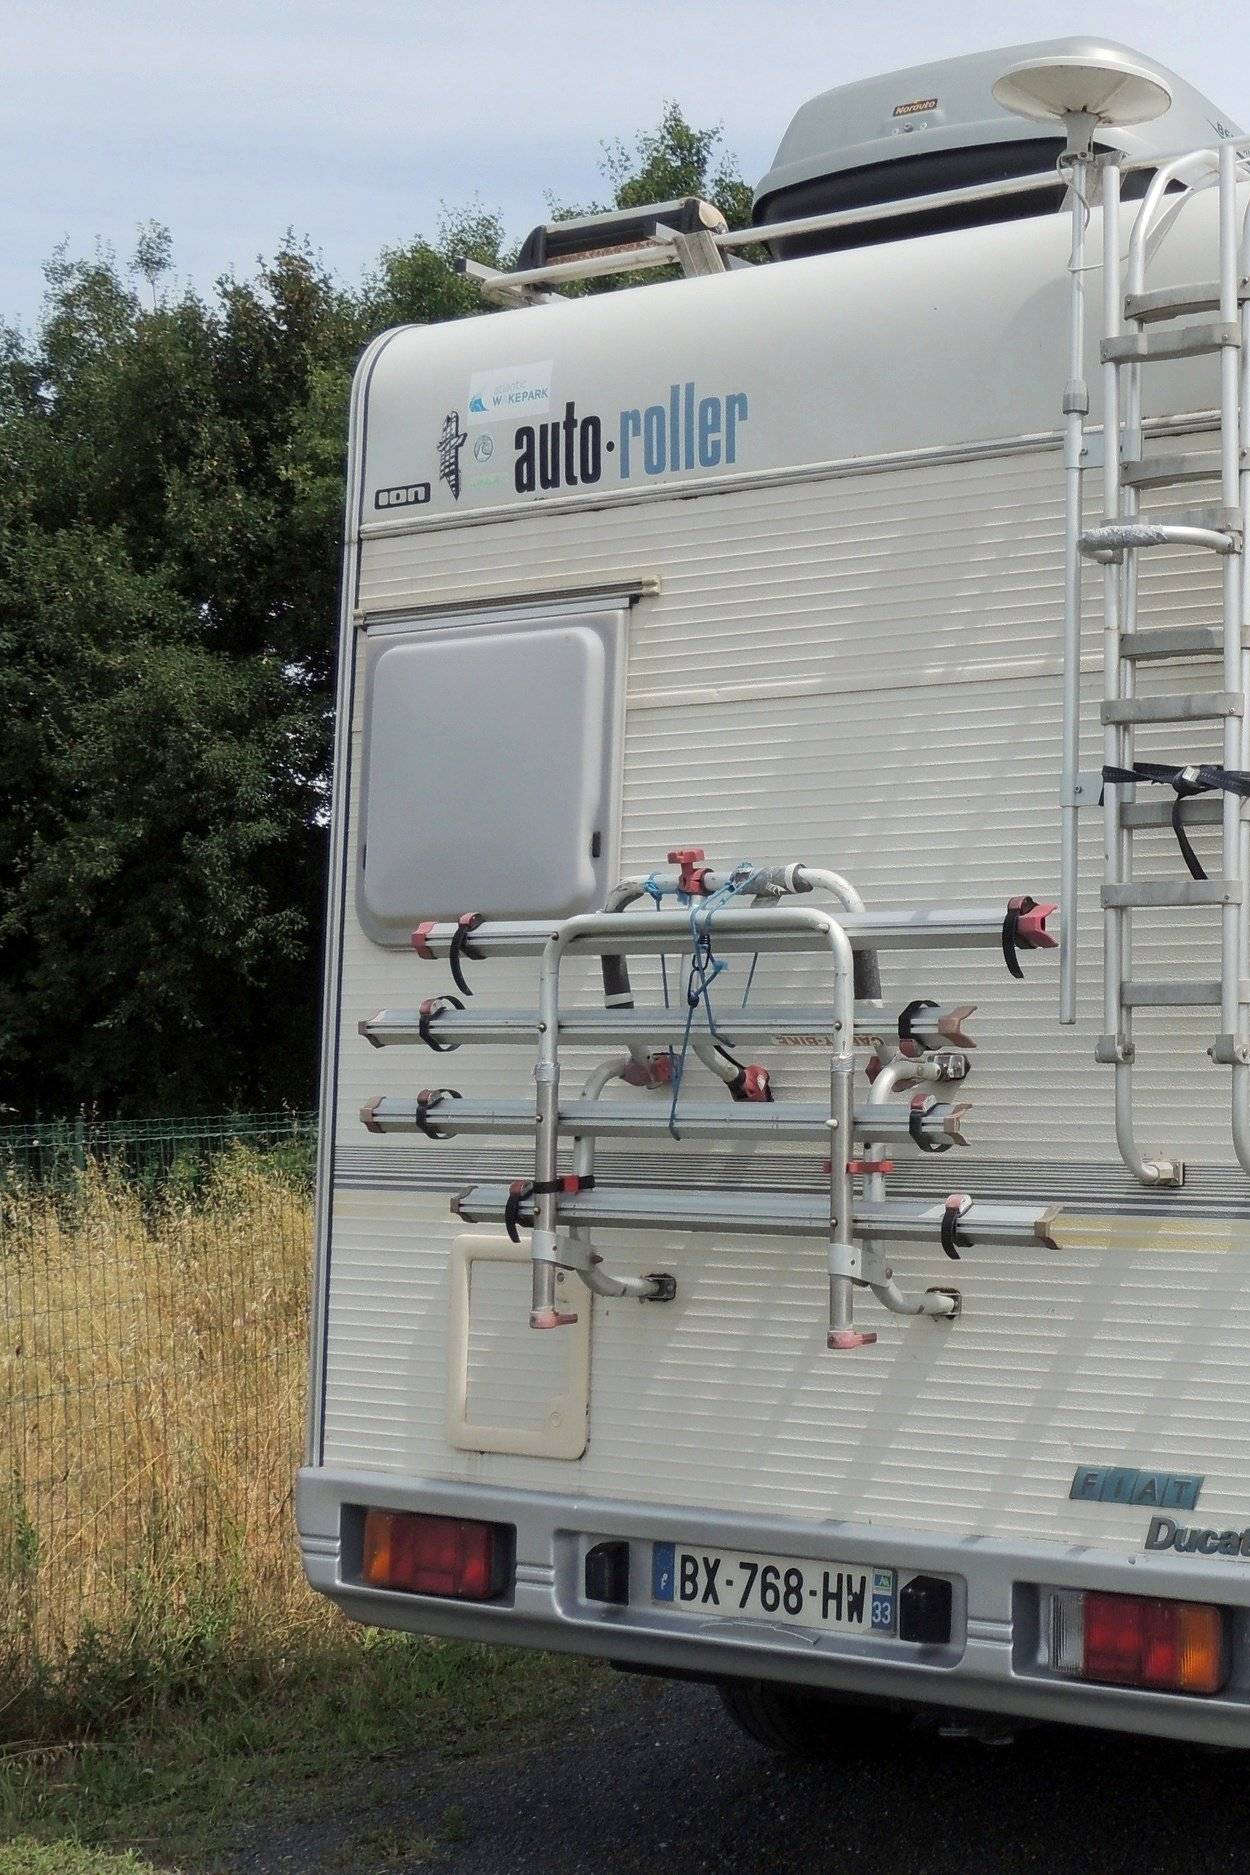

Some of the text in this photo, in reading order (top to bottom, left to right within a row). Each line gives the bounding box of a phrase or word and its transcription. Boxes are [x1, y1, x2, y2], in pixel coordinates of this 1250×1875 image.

[895, 101, 936, 115] Norauto
[1080, 1472, 1192, 1505] FIAT
[680, 1553, 867, 1624] BX-768-HW
[872, 1600, 891, 1624] 33
